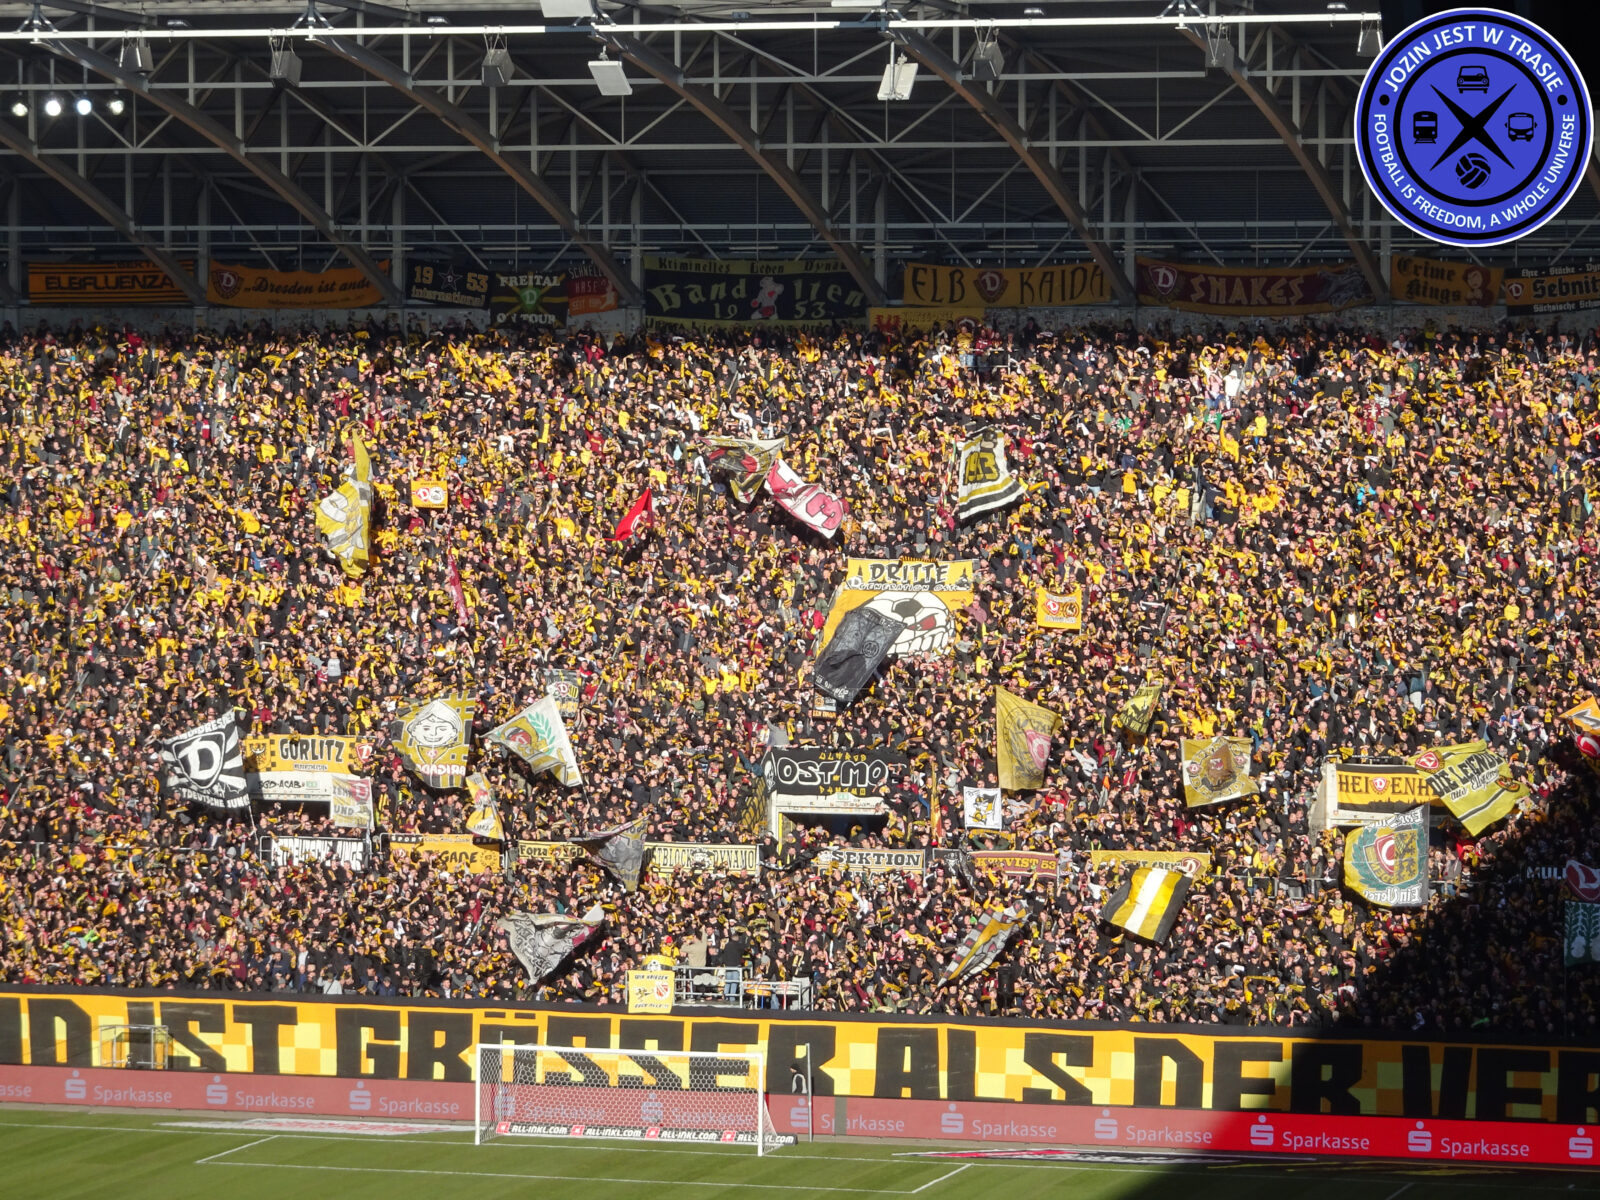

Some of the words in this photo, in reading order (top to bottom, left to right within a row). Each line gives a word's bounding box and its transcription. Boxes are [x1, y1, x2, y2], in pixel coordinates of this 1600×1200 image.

[414, 265, 434, 284] 19
[1397, 256, 1456, 281] Crime
[45, 275, 175, 290] ELBFLUENZA
[318, 279, 336, 293] ist
[466, 272, 489, 293] 53
[500, 275, 561, 287] FREITAL
[912, 266, 965, 304] ELB
[1019, 264, 1104, 305] KAIDA
[1190, 274, 1304, 306] SNAKES
[520, 313, 557, 325] TOUR
[713, 303, 739, 319] 19
[793, 301, 827, 319] 53
[869, 563, 949, 584] DRITTE
[1425, 770, 1459, 797] DIE
[520, 844, 548, 856] Forza
[713, 850, 755, 869] DYNAMO
[831, 850, 921, 867] SEKTION
[1041, 860, 1057, 870] 53
[127, 1000, 298, 1075] IST
[335, 1008, 836, 1098] GRÖSSER
[874, 1027, 1093, 1106] ALS
[1133, 1036, 1362, 1115] DER
[93, 1084, 172, 1104] Sparkasse
[235, 1090, 315, 1108] Sparkasse
[379, 1096, 460, 1114] Sparkasse
[511, 1125, 568, 1135] ALL-INKL.COM
[585, 1126, 642, 1138] ALL-INKL.COM
[661, 1128, 718, 1140] ALL-INKL.COM
[972, 1118, 1057, 1138] Sparkasse
[1126, 1124, 1213, 1144] Sparkasse
[1282, 1131, 1370, 1150] Sparkasse
[1440, 1138, 1530, 1157] Sparkasse
